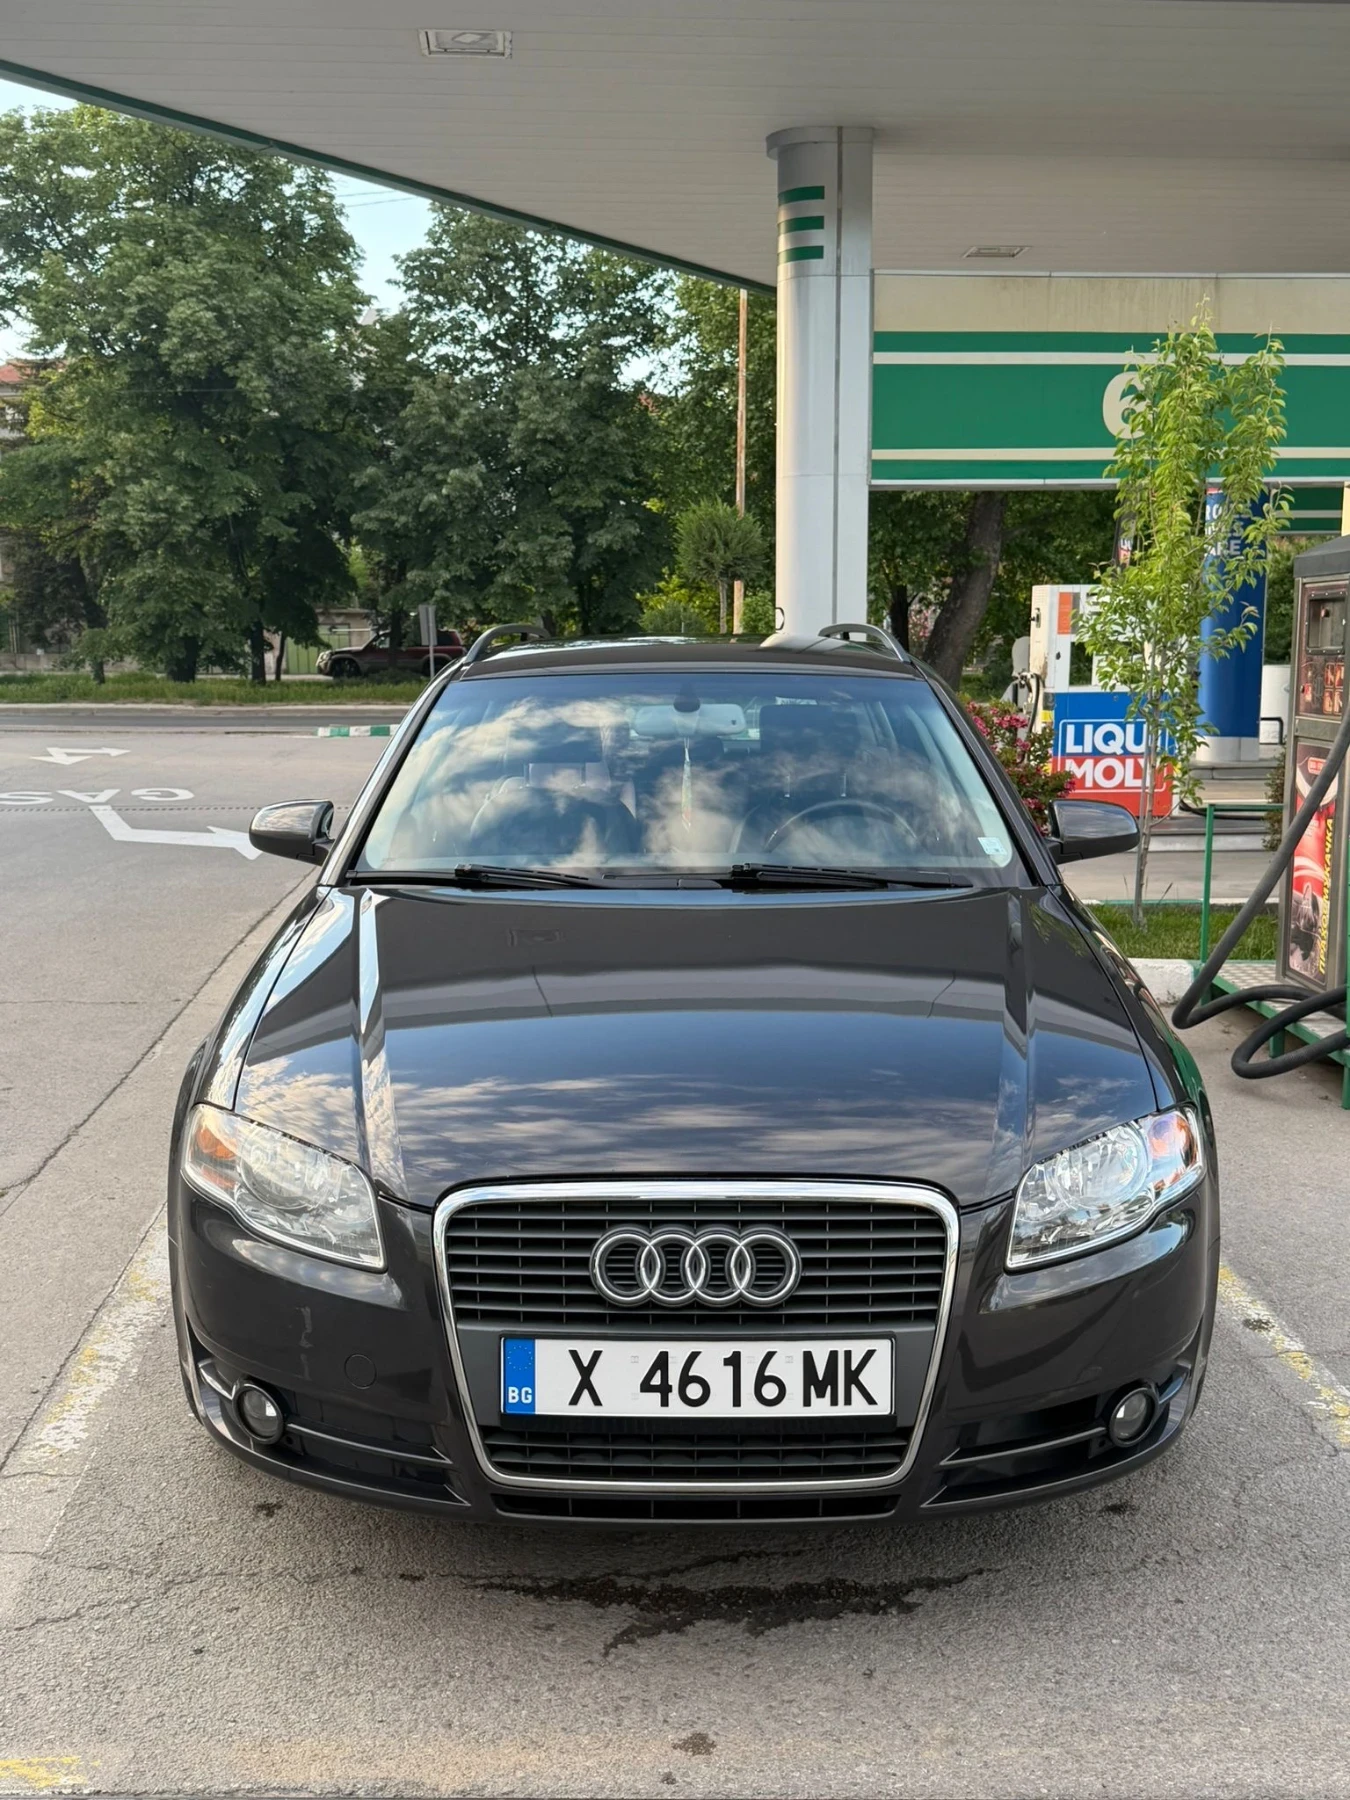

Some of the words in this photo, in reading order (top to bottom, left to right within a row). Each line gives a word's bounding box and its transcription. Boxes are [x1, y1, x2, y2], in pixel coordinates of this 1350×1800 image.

[0, 788, 194, 805] GAS
[568, 1349, 603, 1406] X
[639, 1350, 787, 1407] 4616
[803, 1349, 878, 1407] MK
[508, 1387, 532, 1404] BG
